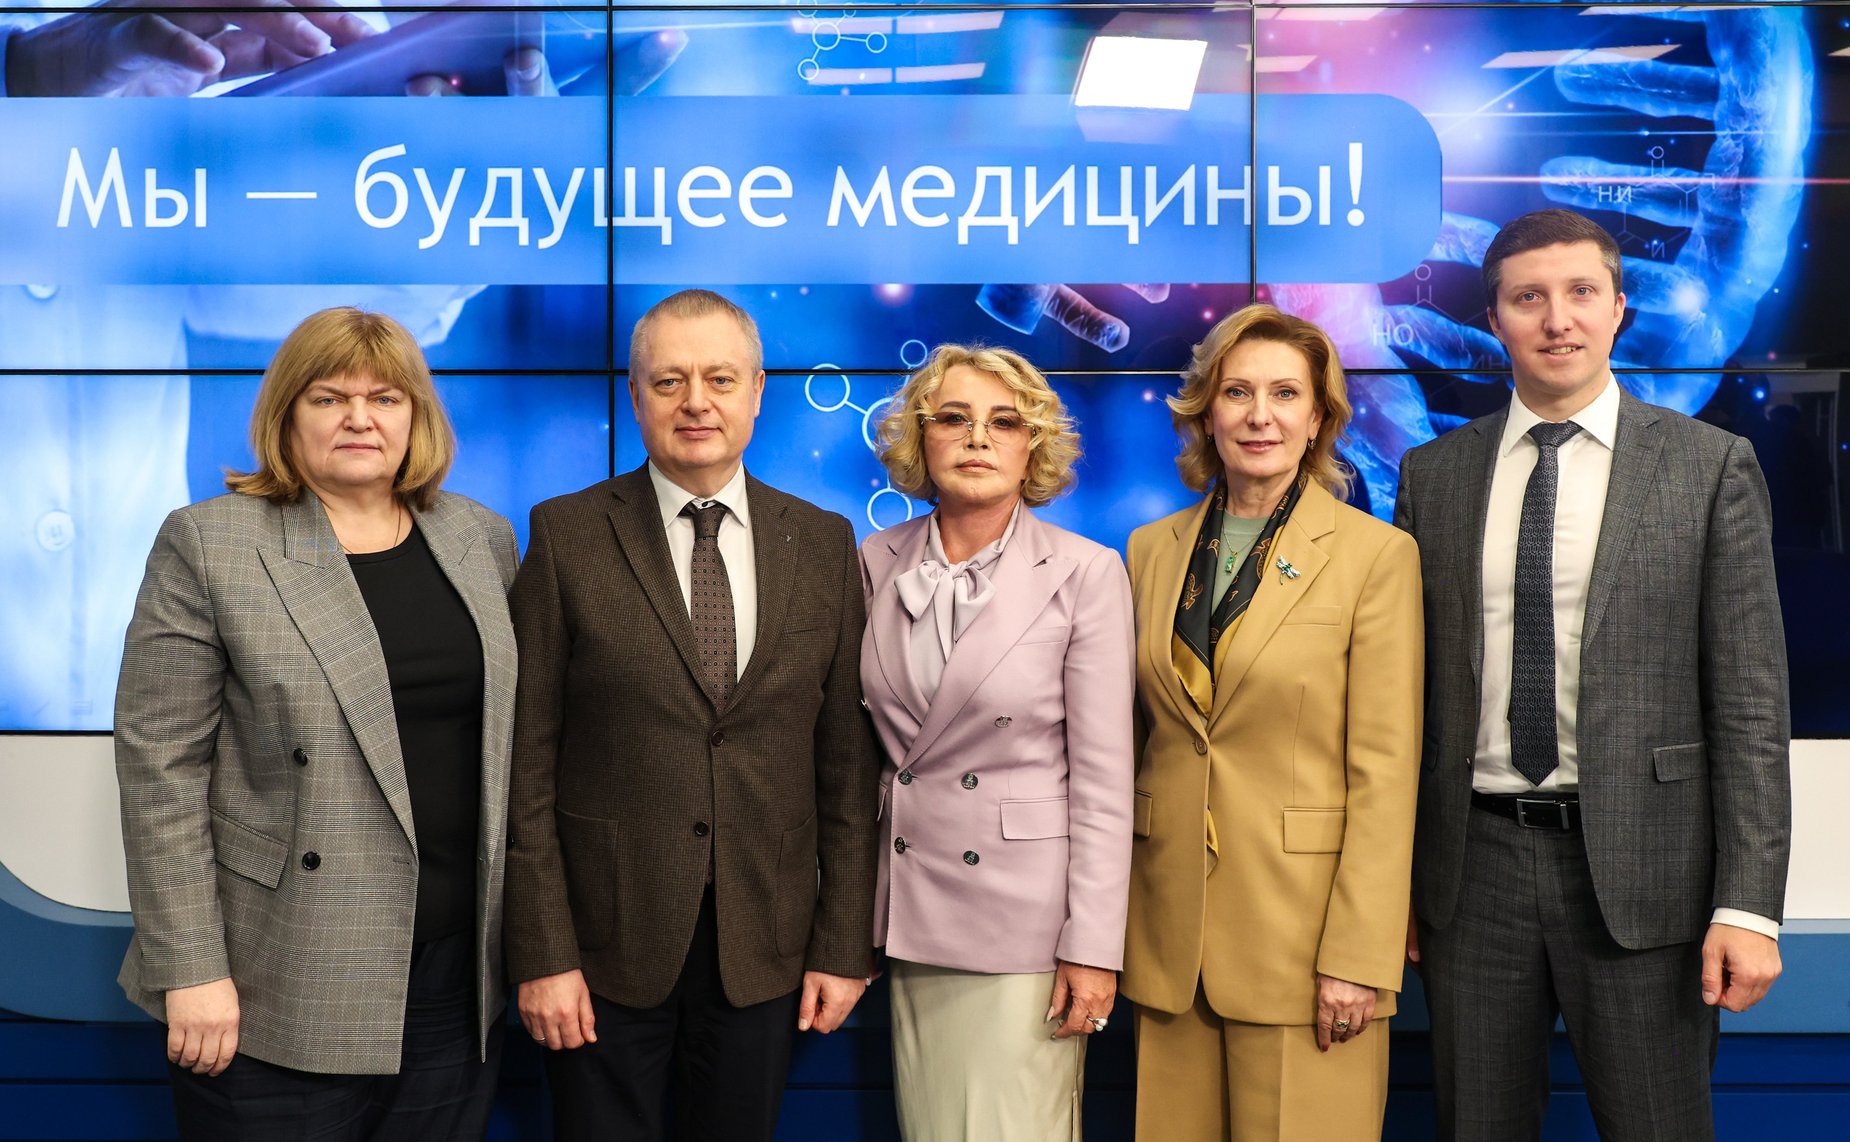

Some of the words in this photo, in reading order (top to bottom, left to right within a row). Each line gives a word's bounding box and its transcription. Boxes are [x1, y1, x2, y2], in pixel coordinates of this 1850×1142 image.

[57, 146, 208, 228] Мы
[355, 143, 793, 249] будущее
[826, 142, 1364, 245] медицины!
